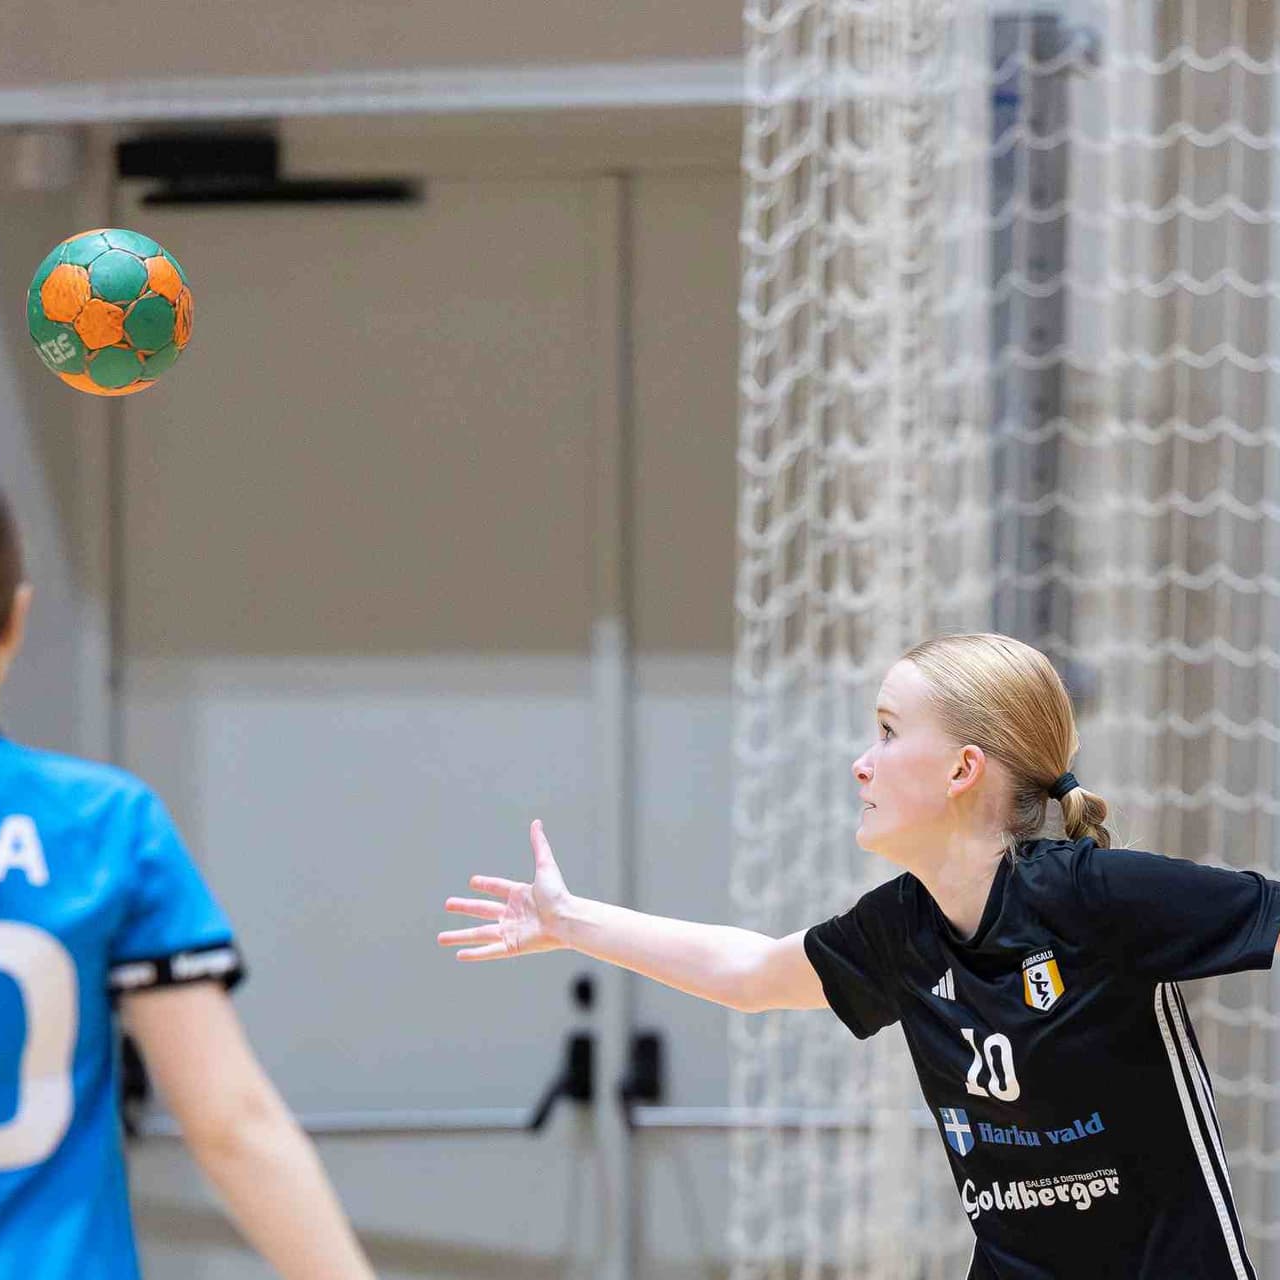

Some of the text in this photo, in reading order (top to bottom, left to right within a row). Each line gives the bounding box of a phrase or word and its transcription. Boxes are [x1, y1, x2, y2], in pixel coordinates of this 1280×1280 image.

[960, 1028, 1020, 1102] 10
[977, 1112, 1105, 1146] Harku vald
[1025, 1168, 1118, 1189] SALES & DISTRIBUTION
[961, 1177, 1120, 1220] Goldberger
